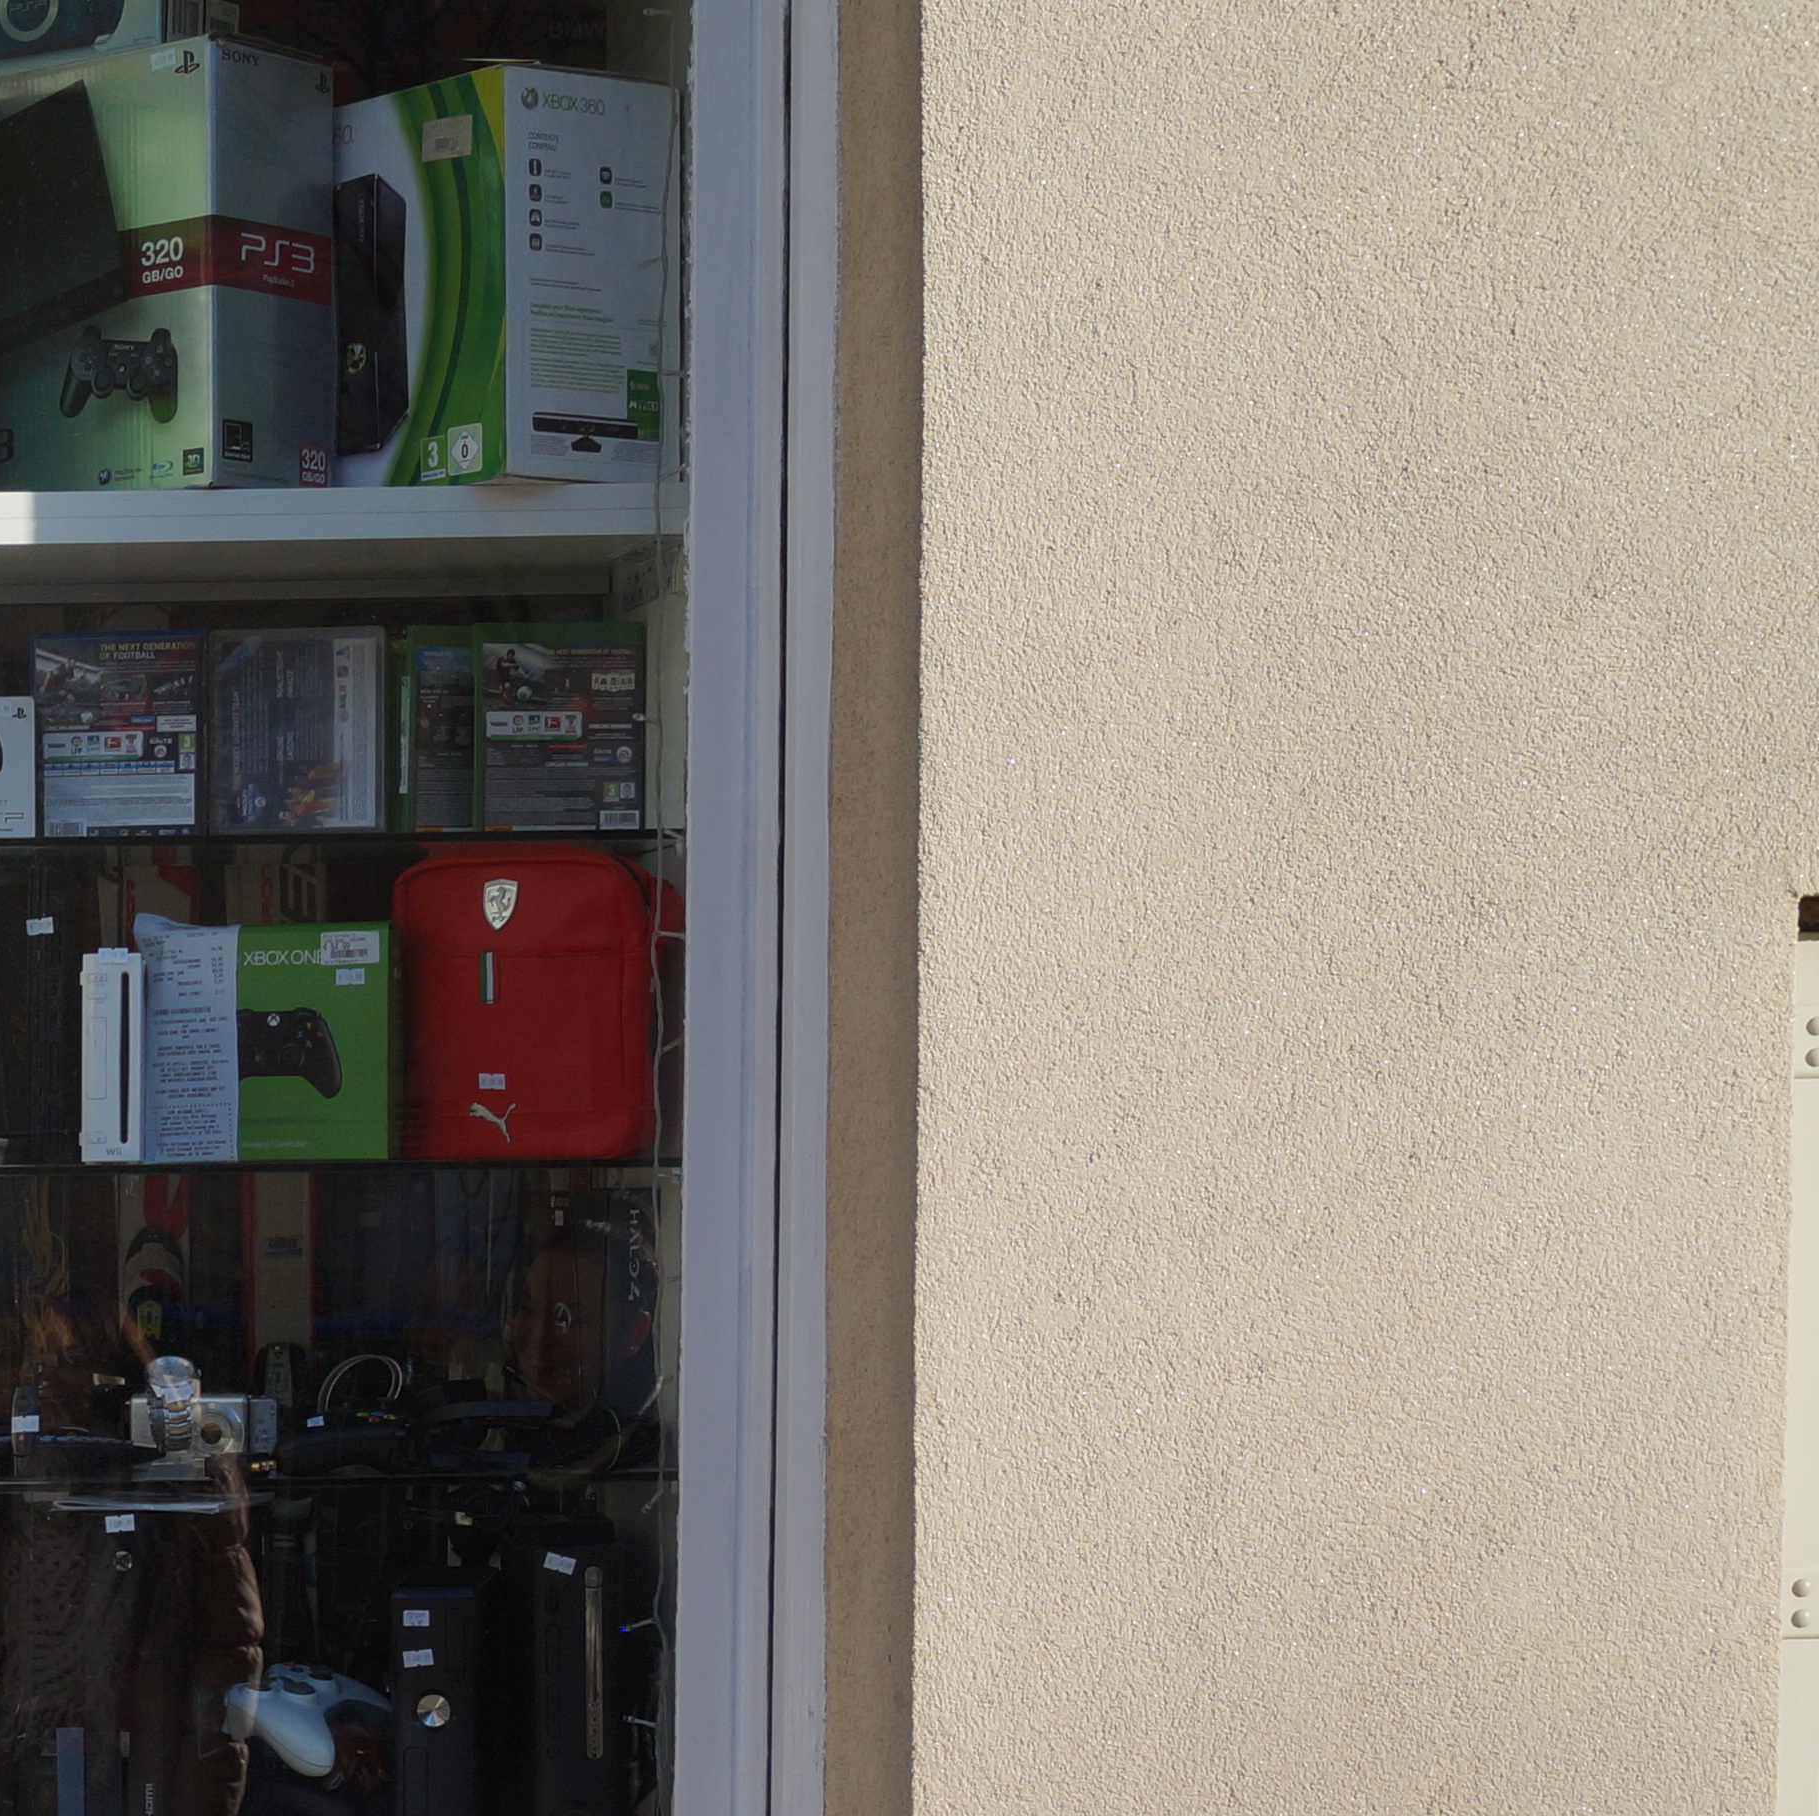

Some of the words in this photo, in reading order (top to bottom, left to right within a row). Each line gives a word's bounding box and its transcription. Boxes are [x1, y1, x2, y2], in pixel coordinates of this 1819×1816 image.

[221, 48, 260, 67] SONY
[541, 92, 579, 113] XBOX
[580, 97, 605, 116] 360
[140, 236, 185, 268] 320
[240, 232, 315, 274] PS3
[141, 264, 184, 284] GB/GO
[301, 448, 326, 472] 320
[427, 441, 439, 468] 3
[243, 950, 289, 966] XBOX
[105, 1147, 122, 1156] Wii
[628, 1208, 640, 1278] HALO
